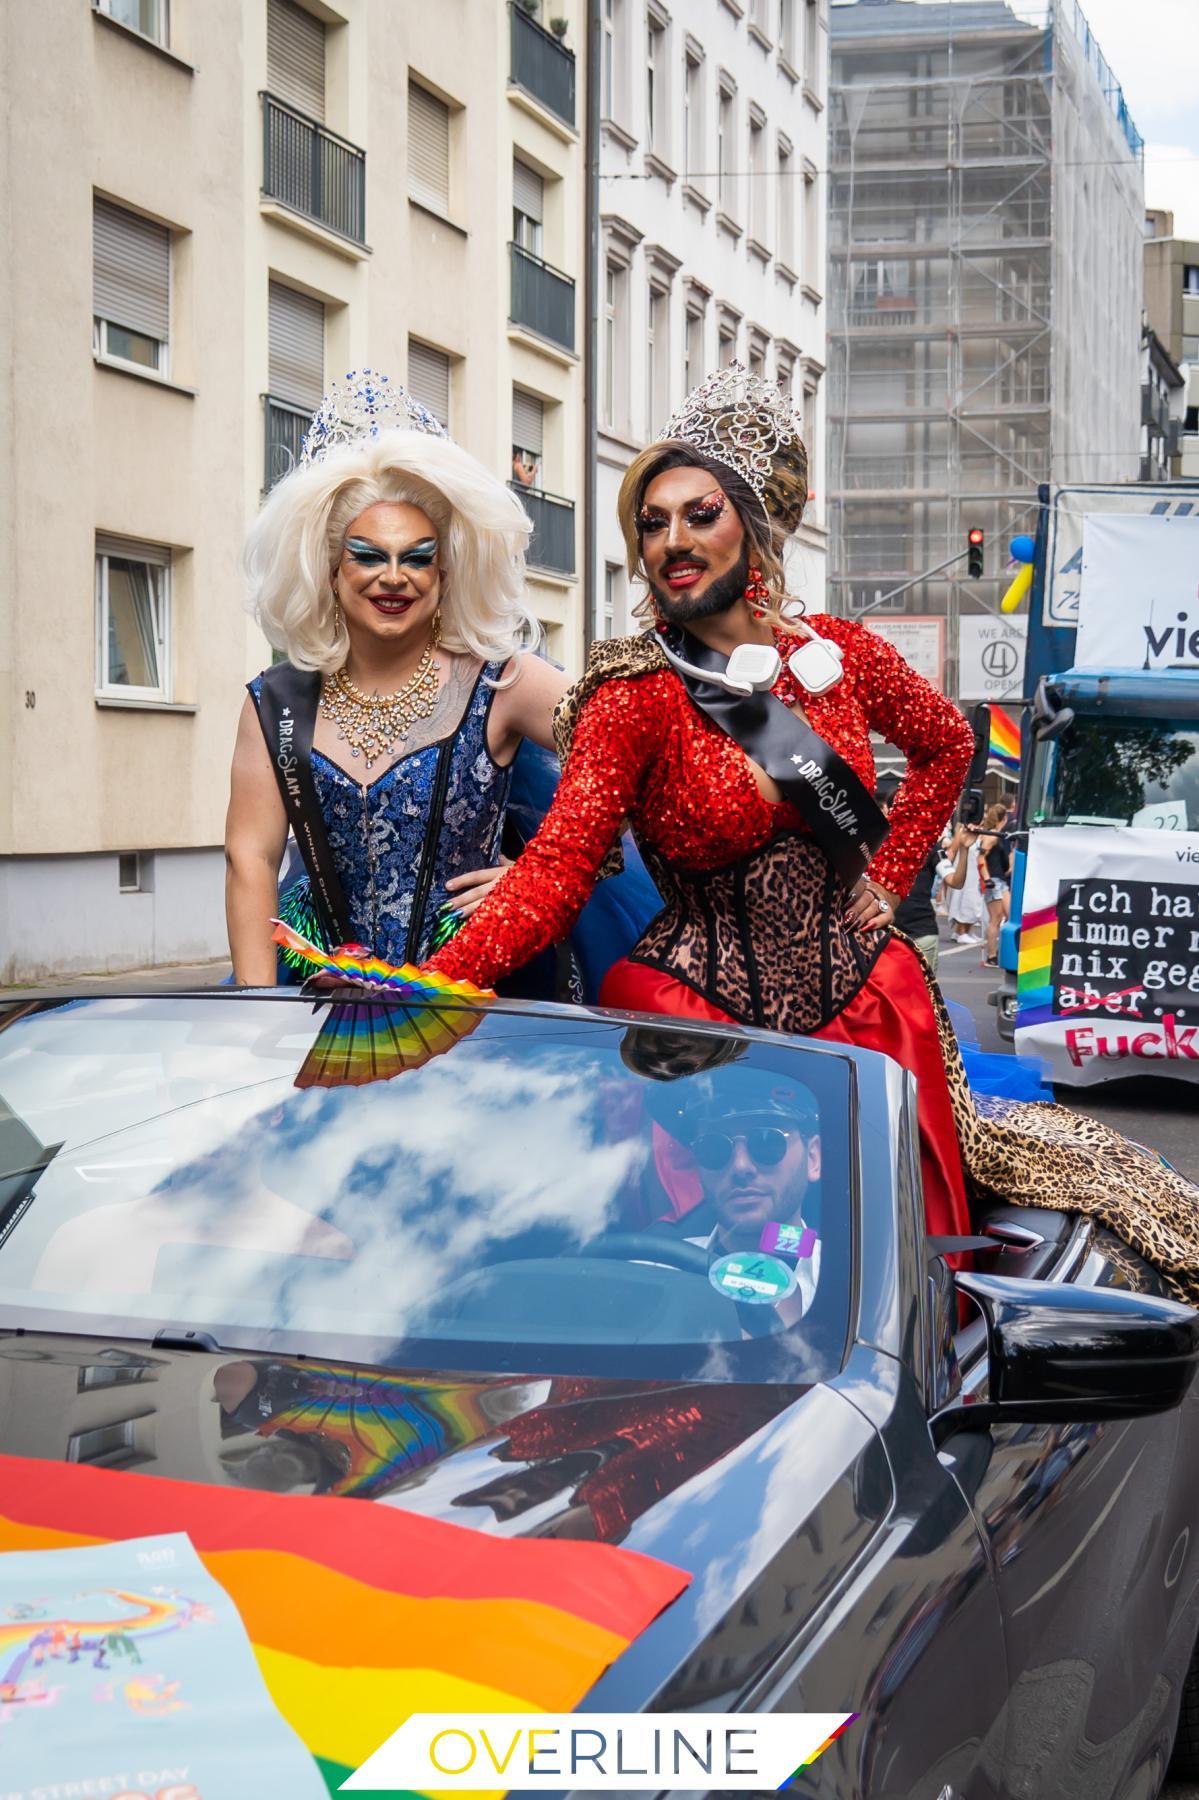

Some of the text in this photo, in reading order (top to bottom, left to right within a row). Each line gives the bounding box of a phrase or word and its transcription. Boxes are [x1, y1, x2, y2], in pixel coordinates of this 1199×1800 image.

[978, 628, 997, 639] WE
[984, 679, 1016, 690] OPEN
[1068, 884, 1199, 918] Ich ha
[1066, 915, 1174, 949] immer
[1060, 950, 1128, 979] nix
[1065, 1013, 1199, 1067] Fuck
[773, 1238, 800, 1253] 22
[744, 1260, 765, 1278] 4
